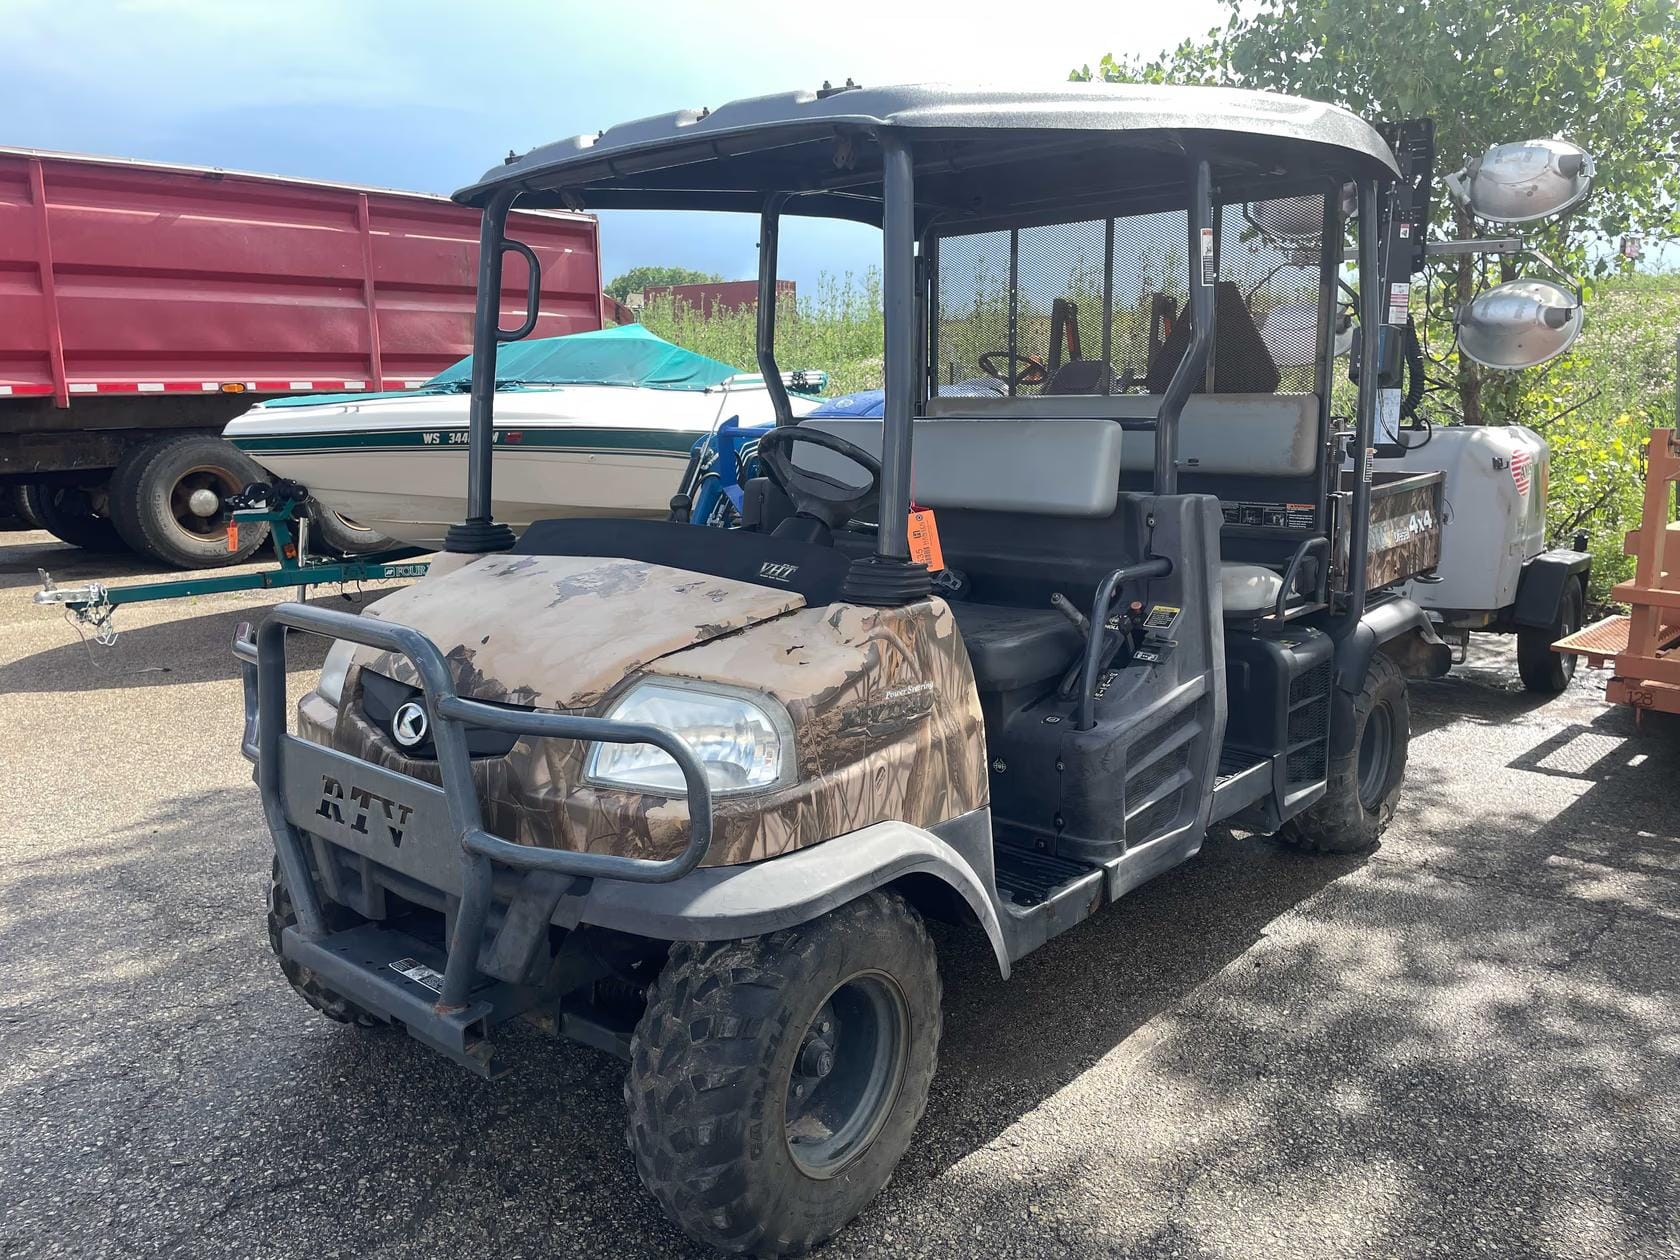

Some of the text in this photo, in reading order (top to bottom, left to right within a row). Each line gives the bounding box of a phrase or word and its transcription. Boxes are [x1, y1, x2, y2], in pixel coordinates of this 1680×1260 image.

[423, 433, 440, 444] WS
[448, 433, 469, 444] 344
[1409, 510, 1433, 534] 4x4
[396, 565, 426, 577] FOUR
[759, 562, 797, 579] VHT
[1627, 691, 1654, 706] 128
[315, 774, 414, 849] RTV
